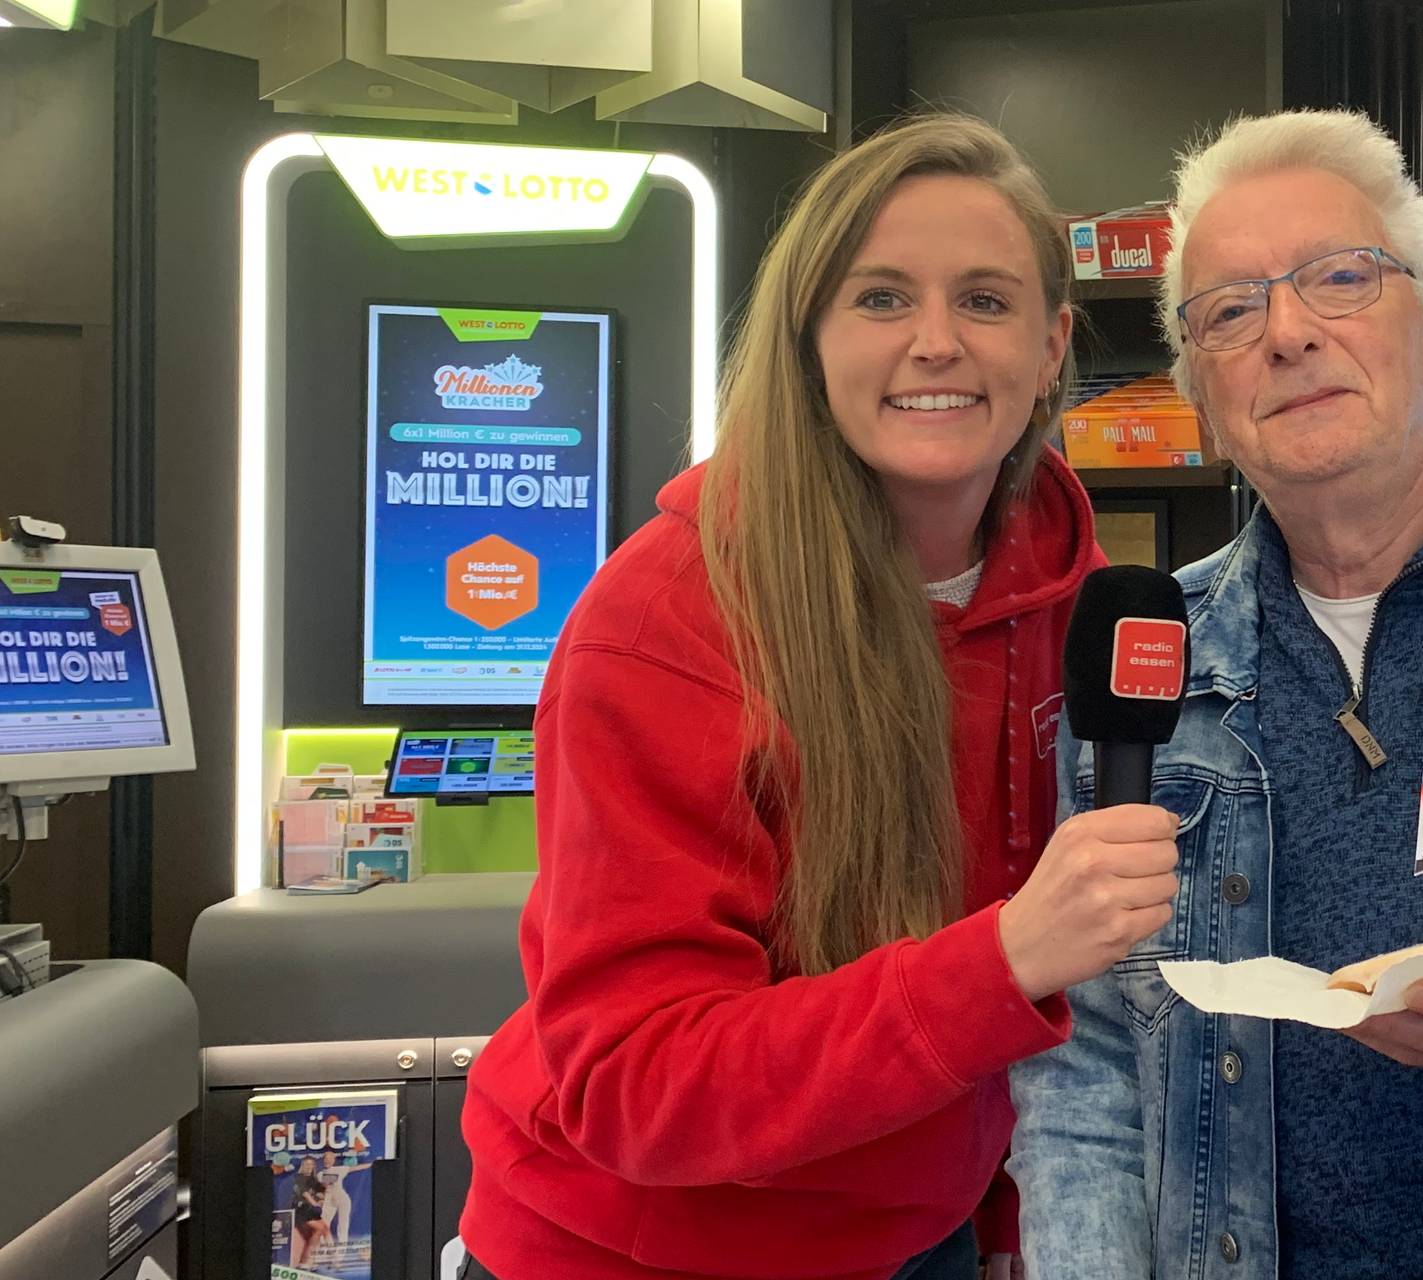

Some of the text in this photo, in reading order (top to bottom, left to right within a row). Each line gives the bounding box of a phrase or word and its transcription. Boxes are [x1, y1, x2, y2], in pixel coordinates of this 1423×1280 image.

[372, 164, 609, 205] WEST LOTTO
[1074, 232, 1092, 245] 200
[1111, 233, 1152, 268] ducal
[458, 320, 526, 330] WEST LOTTO
[438, 369, 538, 396] Millionen
[446, 396, 527, 408] KRACHER
[403, 427, 569, 444] 6x1 Million € zu gewinnen
[1103, 425, 1157, 442] PALL MALL
[422, 451, 556, 471] HOL DIR DIE
[386, 470, 591, 509] MILLION!
[467, 561, 518, 573] Höchste
[461, 573, 503, 584] Chance
[0, 631, 97, 647] OL DIR DIE
[1133, 642, 1174, 653] radio
[0, 650, 129, 683] ILLION!
[1129, 656, 1175, 667] essen
[1361, 735, 1381, 759] DNM
[265, 1115, 371, 1152] GLÜCK
[271, 1268, 298, 1280] 500
